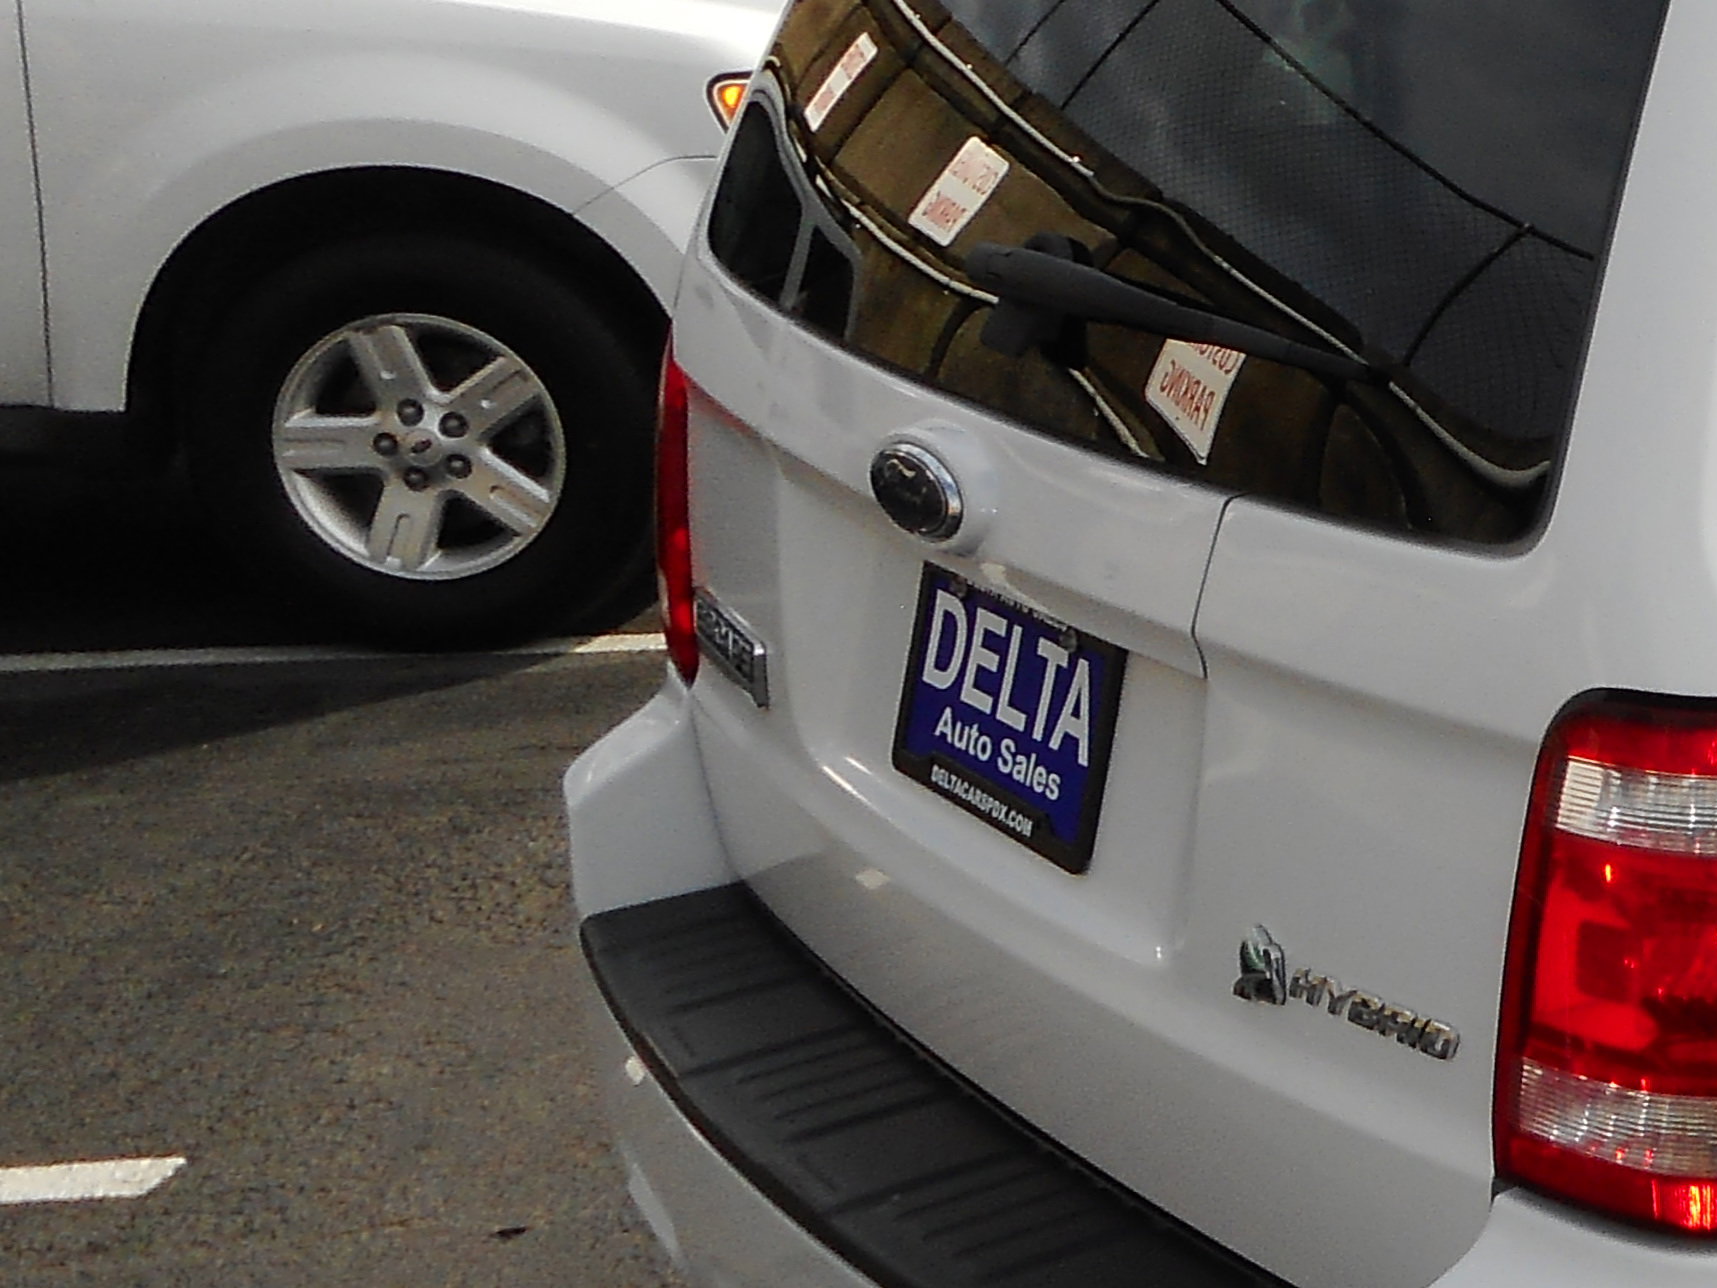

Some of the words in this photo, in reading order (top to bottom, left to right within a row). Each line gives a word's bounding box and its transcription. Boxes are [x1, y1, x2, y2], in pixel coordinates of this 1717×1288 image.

[921, 588, 1090, 768] DELTA
[933, 706, 993, 763] Auto
[996, 736, 1062, 802] Sales
